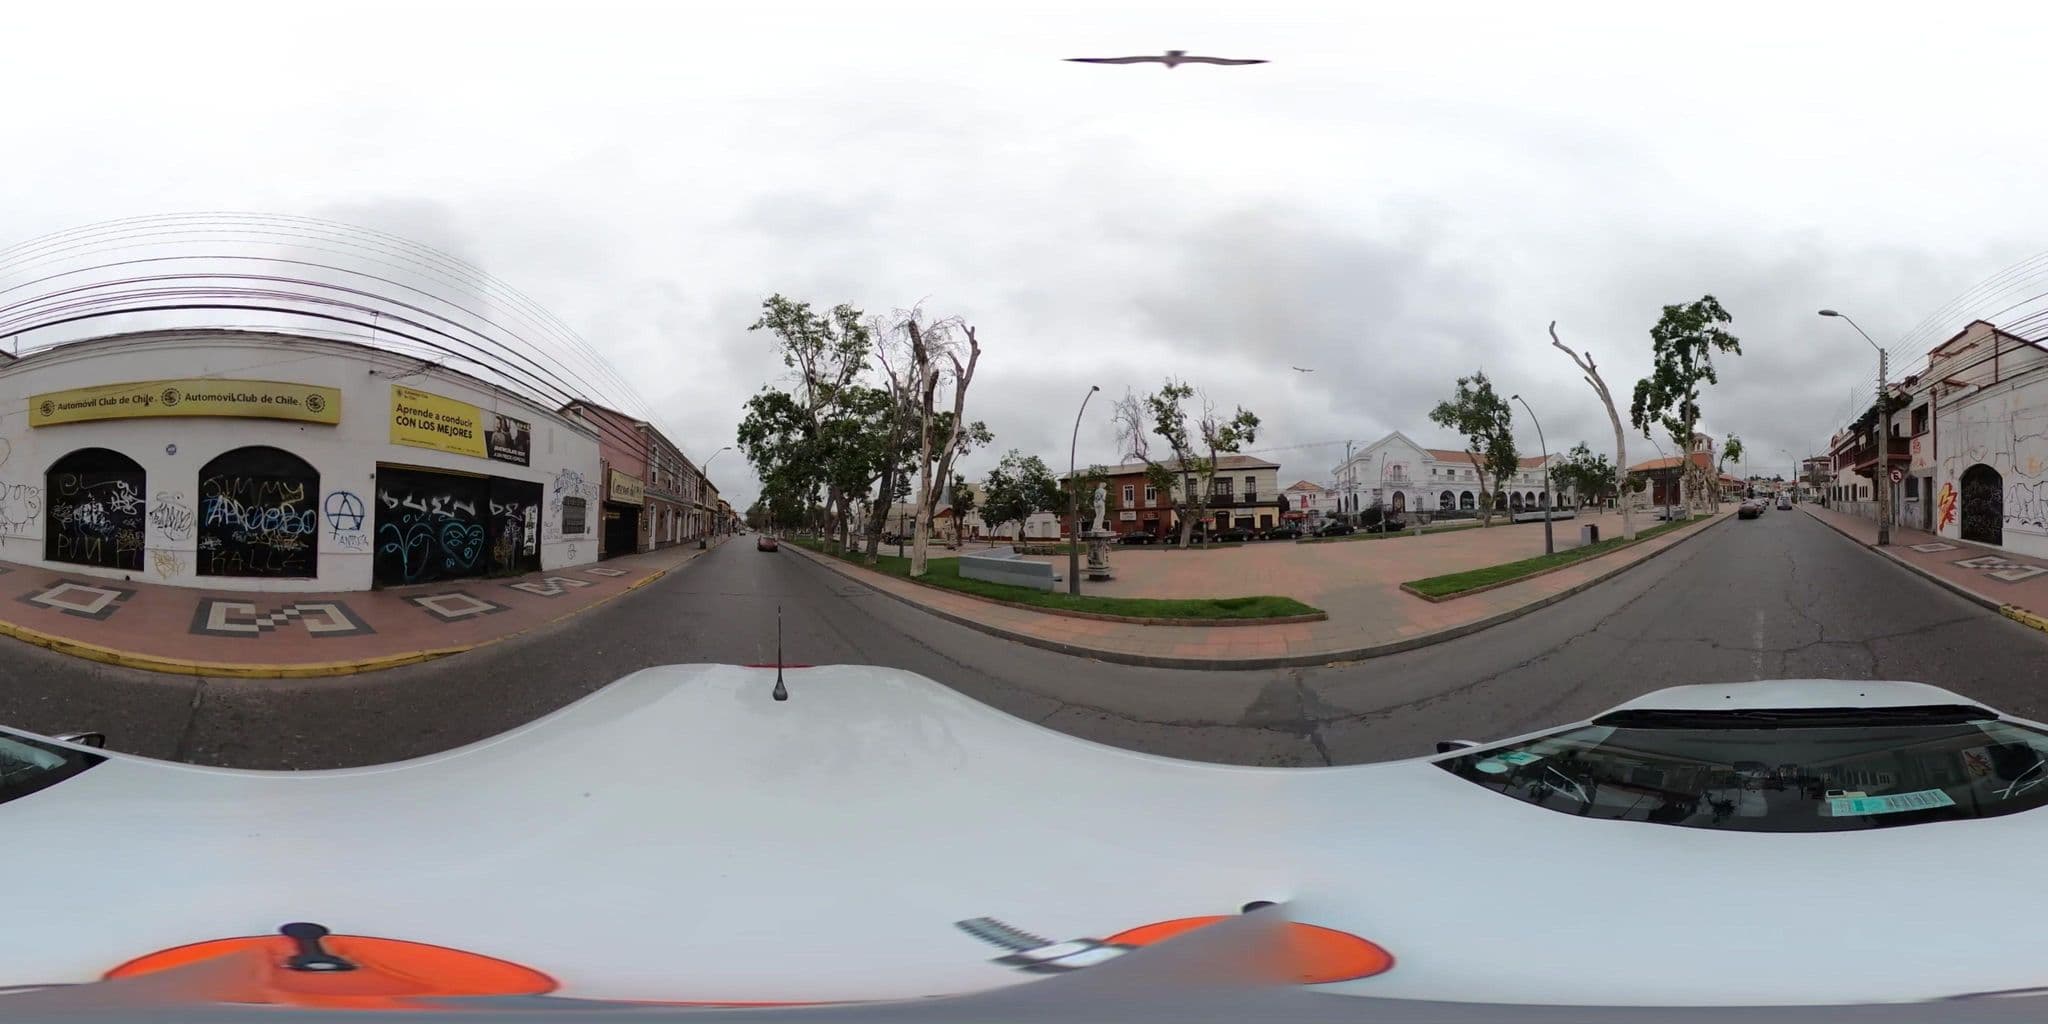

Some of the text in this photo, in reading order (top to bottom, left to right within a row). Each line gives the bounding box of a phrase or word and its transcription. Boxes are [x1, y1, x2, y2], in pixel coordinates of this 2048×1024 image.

[57, 399, 97, 411] Automóvil
[98, 398, 117, 407] Club
[119, 396, 130, 405] de
[236, 393, 257, 403] Club
[260, 394, 272, 404] de
[395, 403, 473, 428] Aprende a conducir
[395, 415, 473, 439] CON LOS MEJORES
